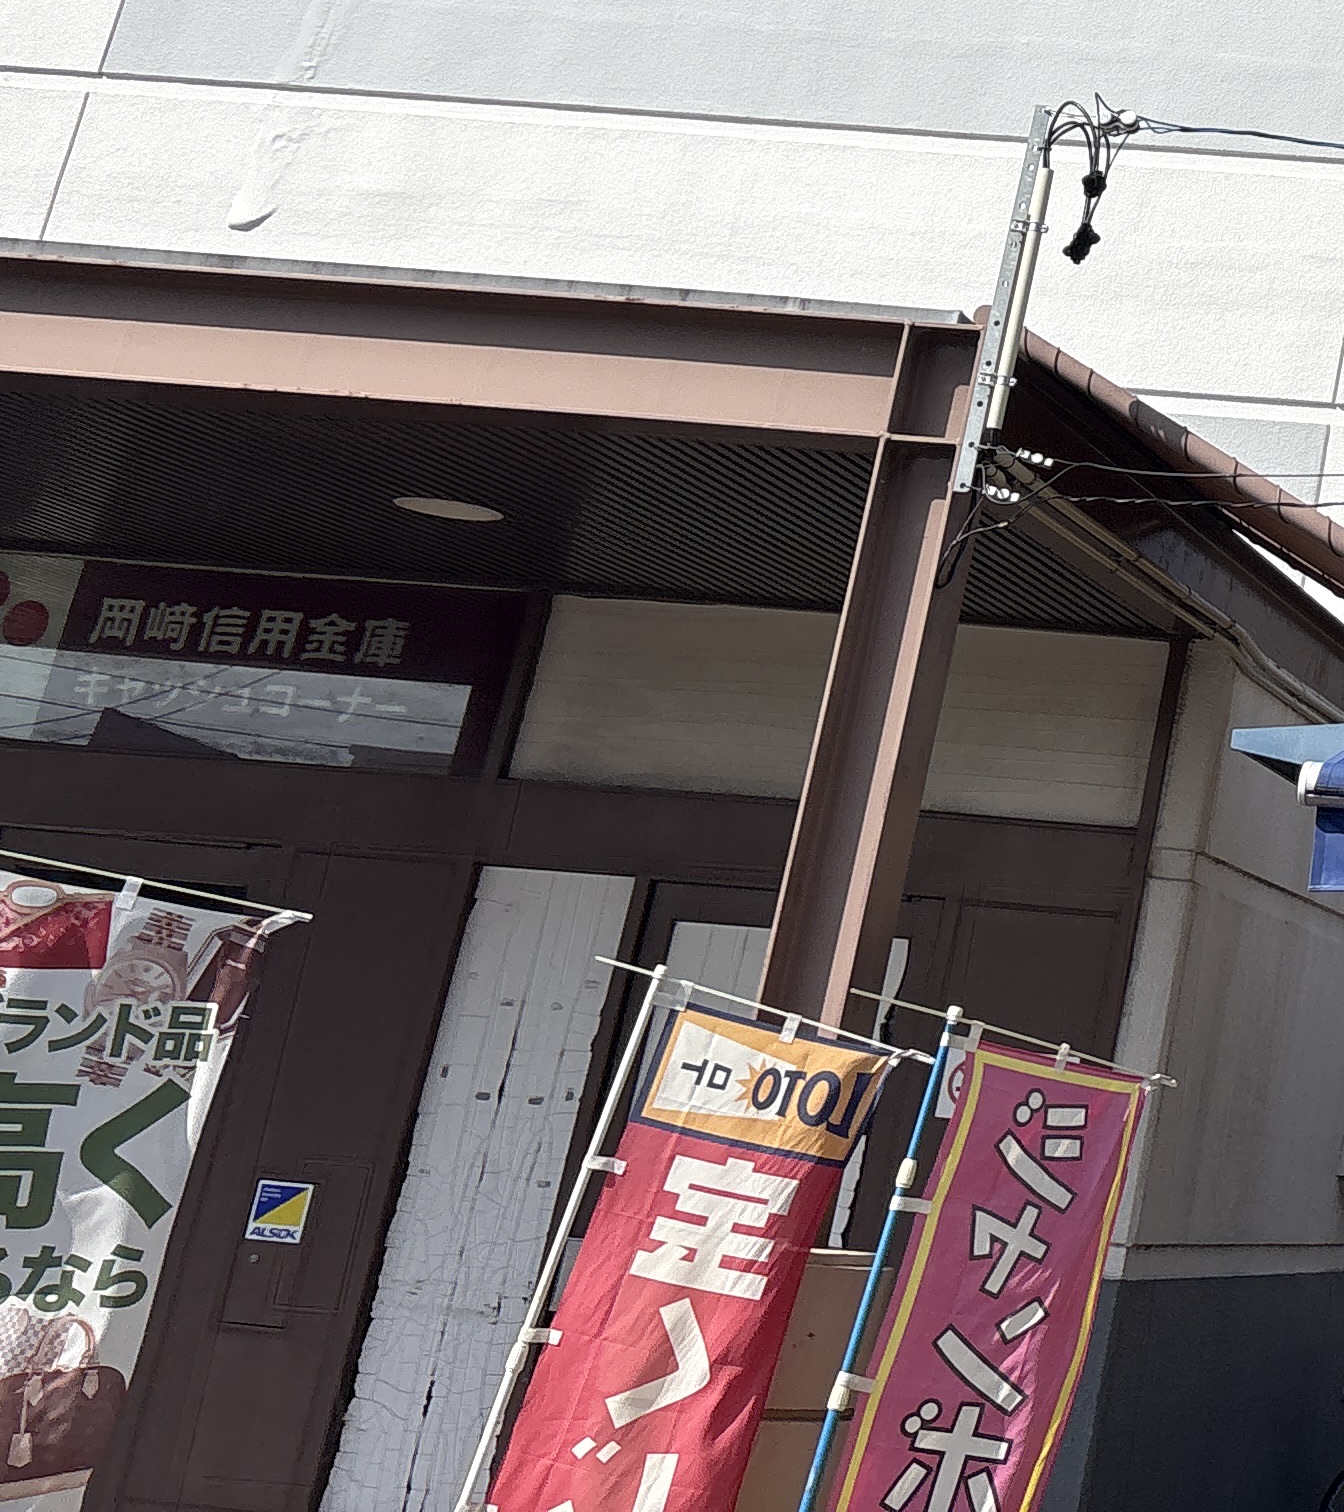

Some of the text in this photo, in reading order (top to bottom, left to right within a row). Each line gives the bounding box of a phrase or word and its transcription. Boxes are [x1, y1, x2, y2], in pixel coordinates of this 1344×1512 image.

[73, 668, 408, 724] キャッシュコーナー
[0, 996, 215, 1063] ランド品
[249, 1226, 300, 1241] ALSOK
